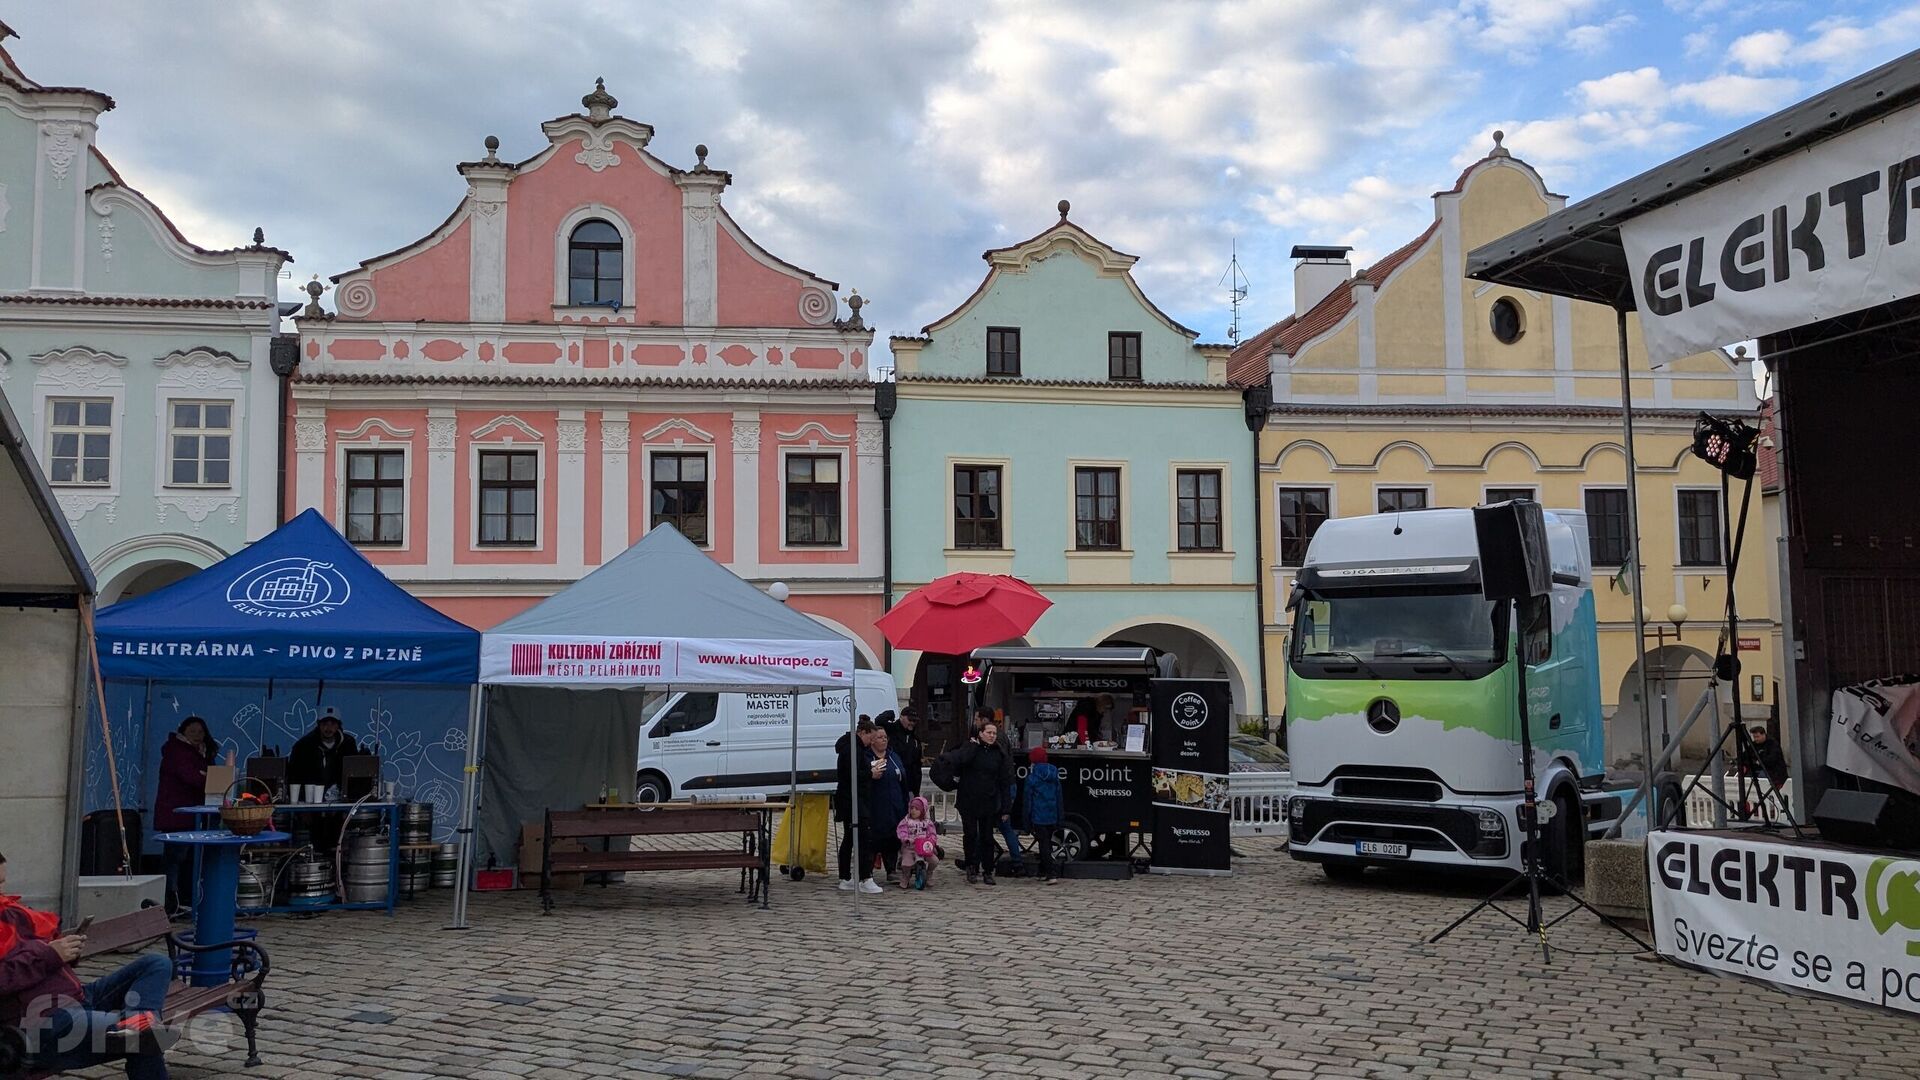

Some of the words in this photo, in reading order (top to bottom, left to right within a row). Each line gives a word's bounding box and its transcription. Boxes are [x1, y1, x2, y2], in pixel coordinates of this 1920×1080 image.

[233, 602, 335, 618] ELEKTRÁRNA
[112, 640, 254, 656] ELEKTRÁRNA
[289, 645, 336, 659] PIVO
[344, 647, 354, 659] Z
[362, 646, 422, 661] PLZNĚ
[548, 641, 606, 660] KULTURNÍ
[610, 641, 661, 660] ZAŘÍZENÍ
[698, 653, 829, 668] www.kulturape.cz
[548, 664, 584, 676] MĚSTA
[590, 664, 661, 676] PELHŘIMOVA
[1048, 676, 1128, 689] NESPRESSO
[746, 700, 789, 710] MASTER
[1178, 695, 1202, 705] Coffee
[814, 706, 841, 714] elektrický
[1180, 718, 1200, 727] point
[1013, 763, 1068, 780] ofe
[1079, 763, 1132, 783] point
[1088, 787, 1132, 797] NESPRESSO
[1171, 826, 1211, 837] NESPRESSO
[1362, 842, 1377, 852] EL6
[1674, 917, 1779, 971] Svezte
[1791, 950, 1832, 983] se
[1845, 961, 1866, 991] a
